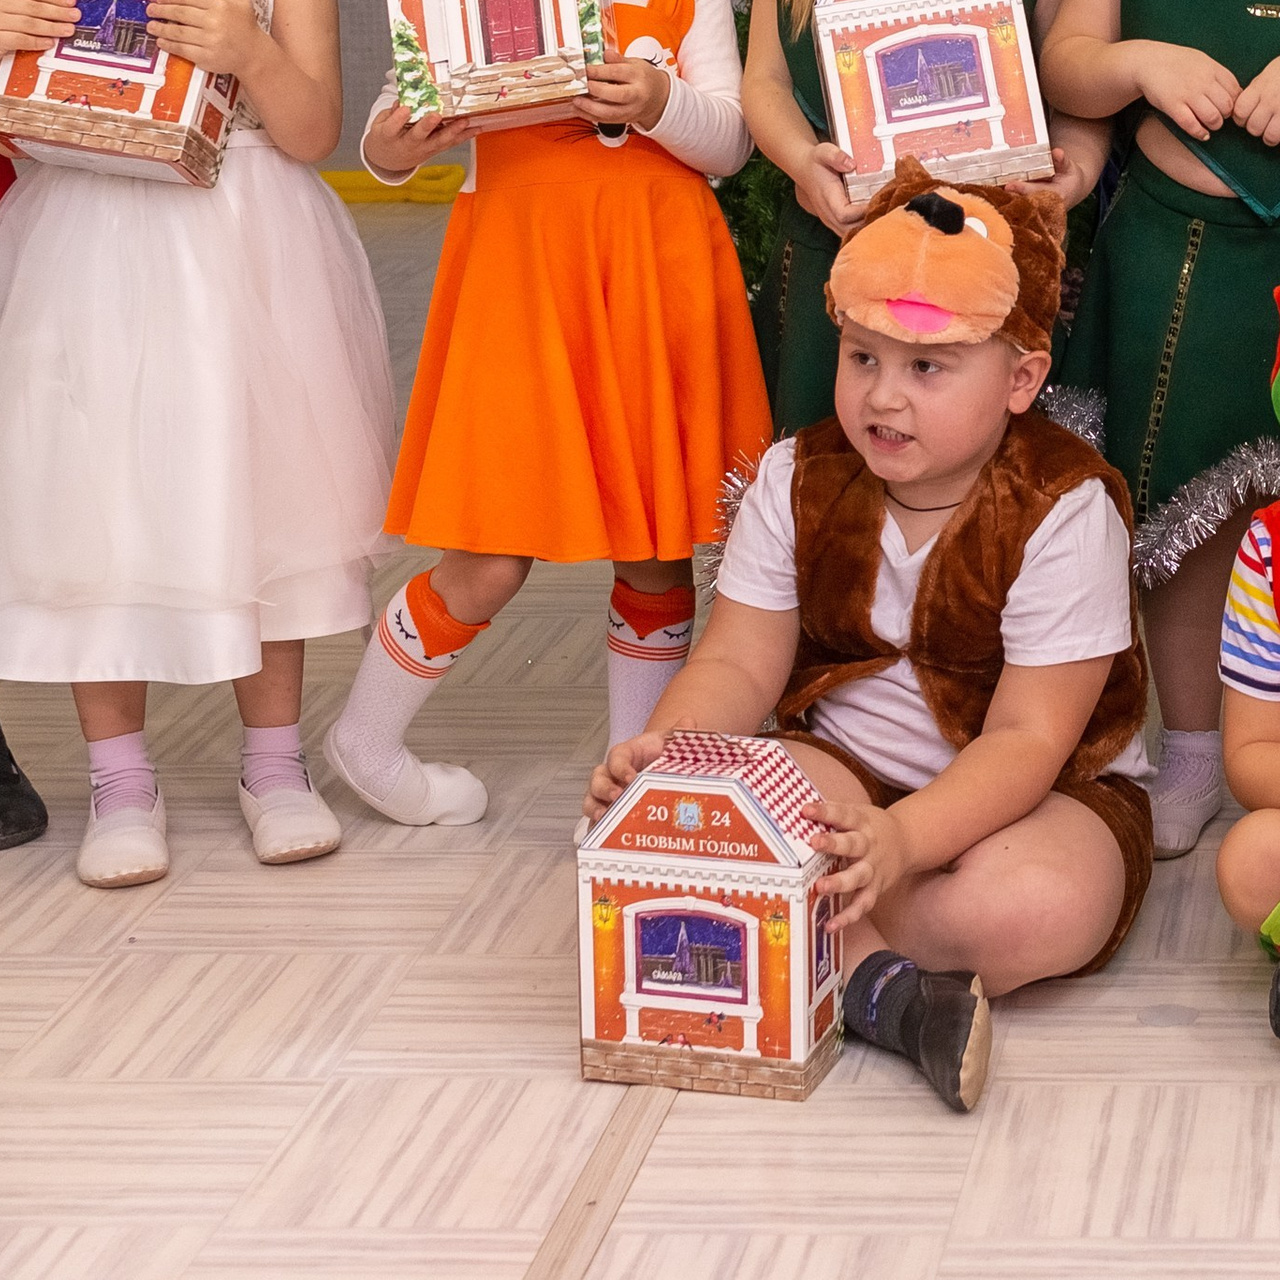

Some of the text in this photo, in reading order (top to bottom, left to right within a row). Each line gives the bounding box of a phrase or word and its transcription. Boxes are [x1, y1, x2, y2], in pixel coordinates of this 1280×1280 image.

[646, 805, 731, 827] 20 24
[621, 833, 758, 857] С НОВЫМ ГОДОМ!
